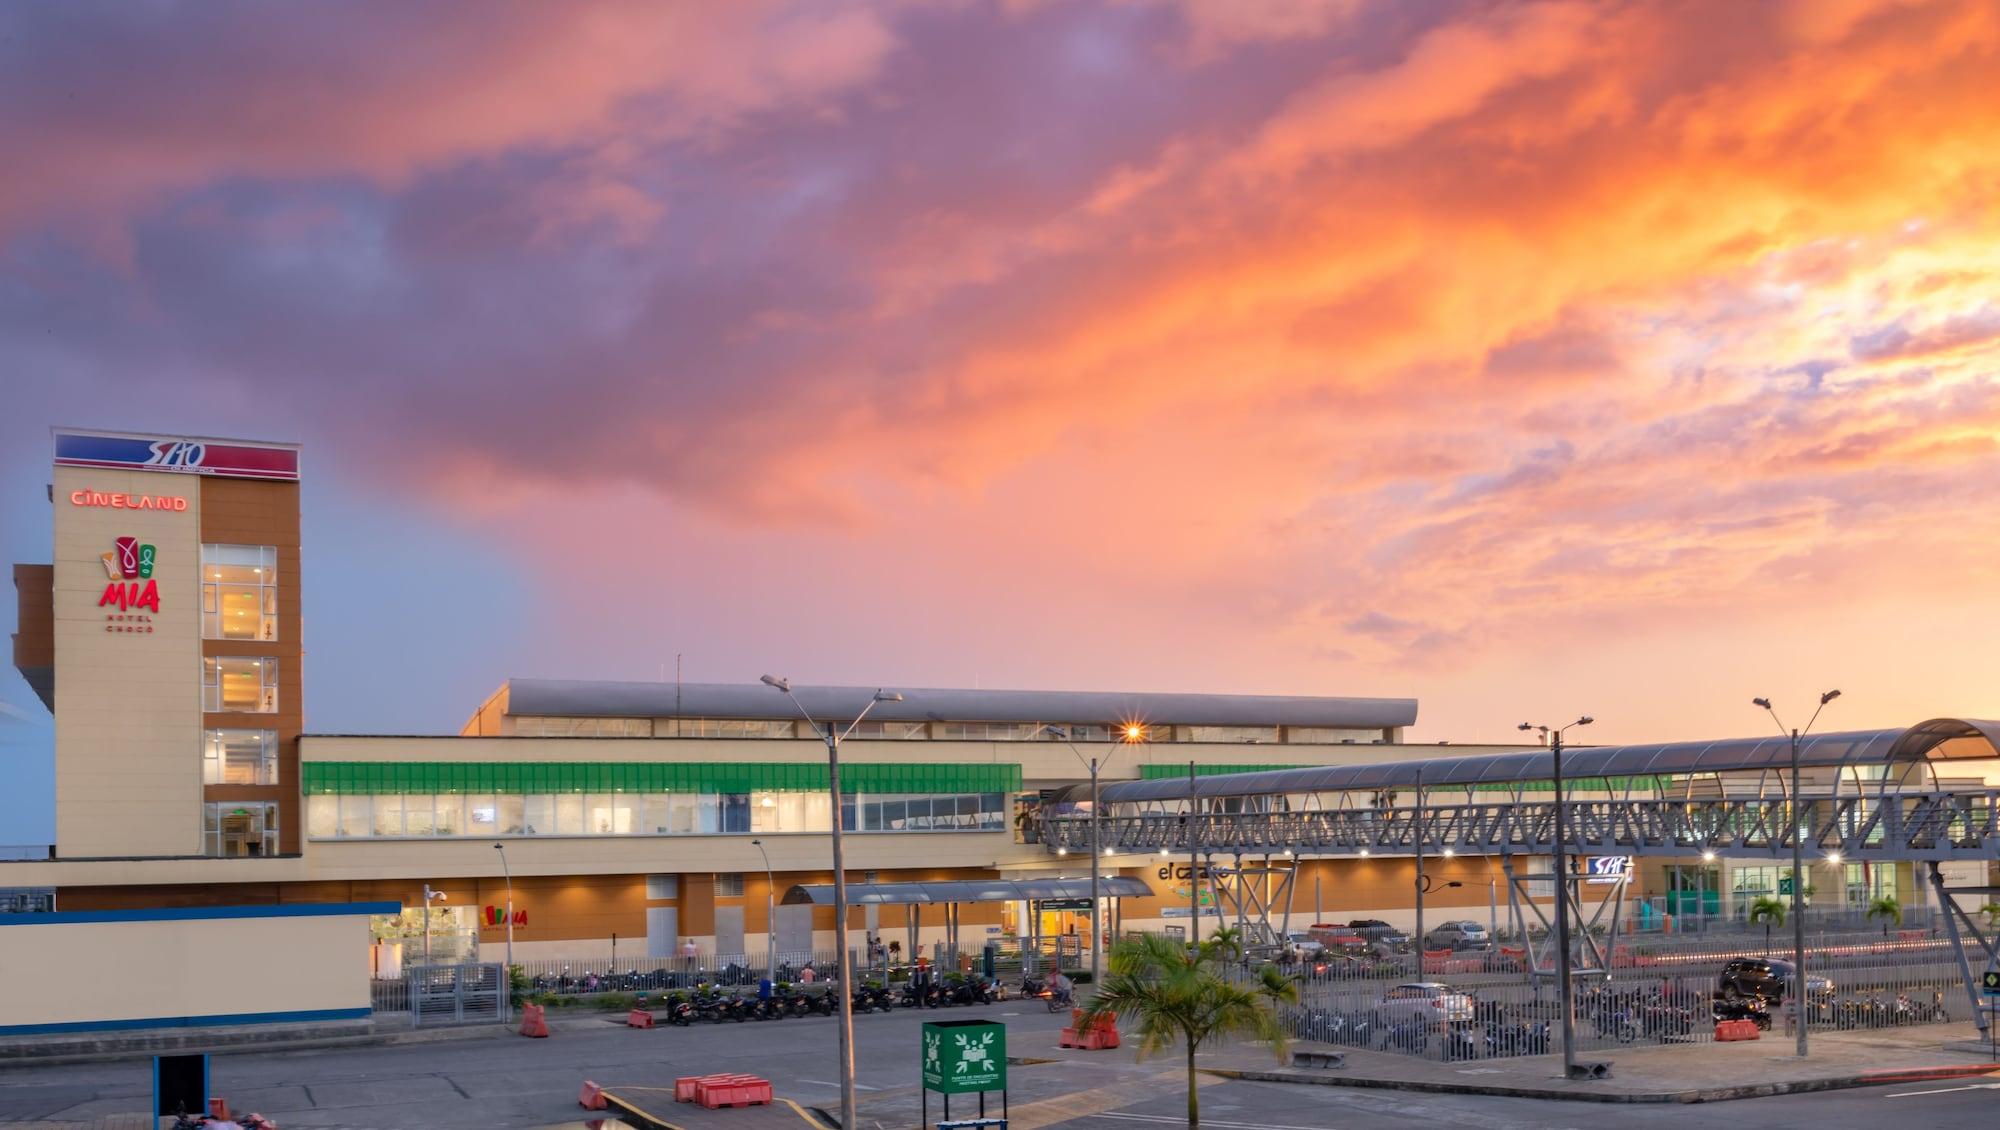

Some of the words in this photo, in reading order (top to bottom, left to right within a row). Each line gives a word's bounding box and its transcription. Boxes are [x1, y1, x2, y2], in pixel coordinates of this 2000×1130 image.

[144, 440, 206, 467] SAO
[98, 579, 160, 613] MIA
[1158, 862, 1174, 880] el
